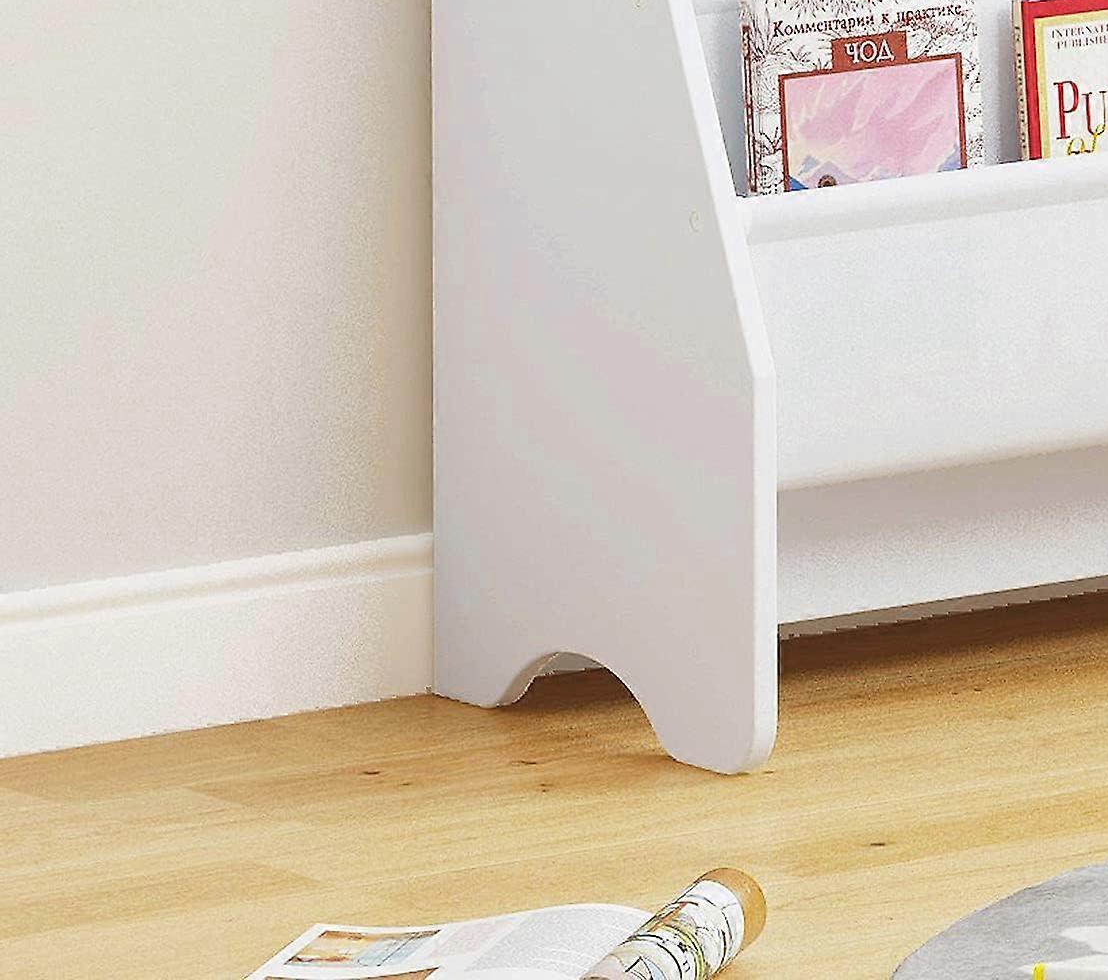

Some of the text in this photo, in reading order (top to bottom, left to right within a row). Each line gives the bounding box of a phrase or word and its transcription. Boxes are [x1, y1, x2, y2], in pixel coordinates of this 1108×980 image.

[773, 3, 962, 38] Комментарий к практике
[845, 39, 895, 63] ЧОД
